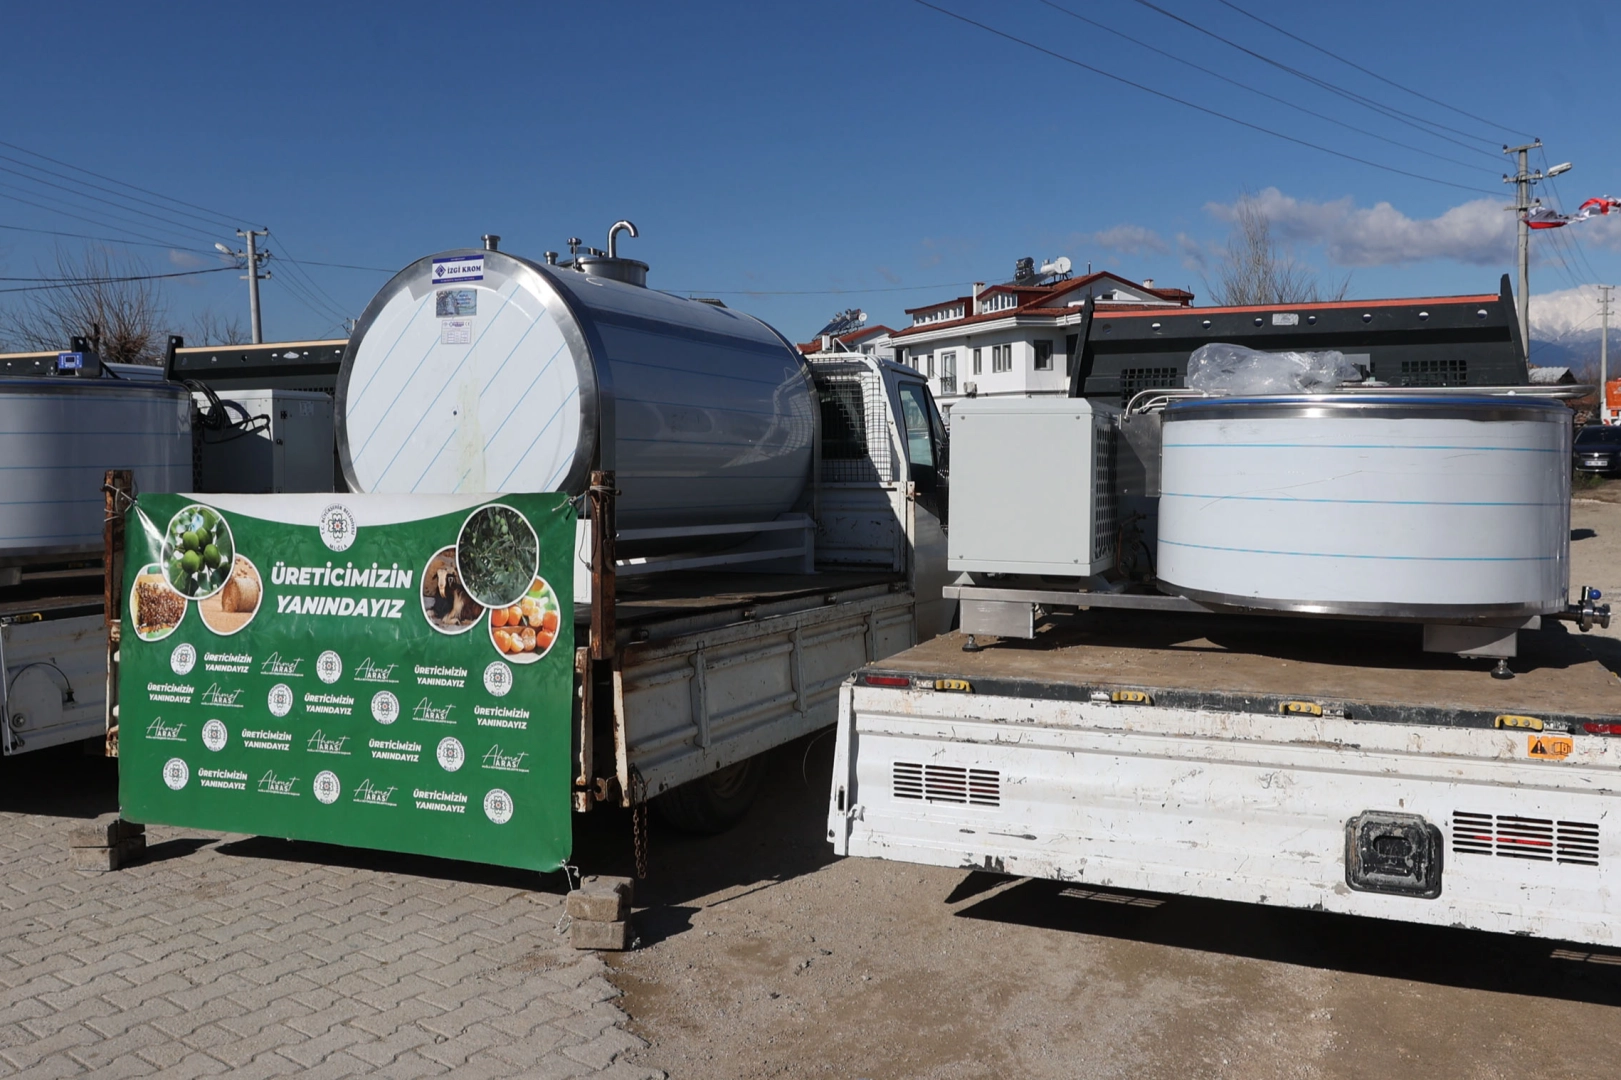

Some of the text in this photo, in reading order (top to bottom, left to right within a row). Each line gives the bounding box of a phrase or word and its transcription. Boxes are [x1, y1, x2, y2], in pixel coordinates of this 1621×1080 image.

[448, 265, 481, 274] İZGİ KROM
[271, 561, 413, 588] ÜRETİCİMİZİN
[277, 595, 405, 618] YANINDAYIZ
[204, 652, 252, 663] ÜRETİCİMİZİN
[205, 664, 249, 673] YANINDAYIZ
[414, 665, 468, 677] ÜRETİCİMİZİN
[147, 682, 194, 694] ÜRETİCİMİZİN
[417, 677, 465, 688] YANINDAYIZ
[149, 694, 191, 703] YANINDAYIZ
[304, 692, 354, 705] ÜRETİCİMİZİN
[306, 705, 352, 715] YANINDAYIZ
[474, 705, 530, 719] ÜRETİCİMİZİN
[477, 718, 527, 729] YANINDAYIZ
[242, 729, 292, 741] ÜRETİCİMİZİN
[244, 740, 290, 751] YANINDAYIZ
[369, 738, 421, 752] ÜRETİCİMİZİN
[372, 751, 419, 762] YANINDAYIZ
[496, 760, 517, 768] ARAS
[198, 768, 247, 780] ÜRETİCİMİZİN
[200, 780, 246, 790] YANINDAYIZ
[413, 788, 468, 803] ÜRETİCİMİZİN
[416, 801, 465, 813] YANINDAYIZ
